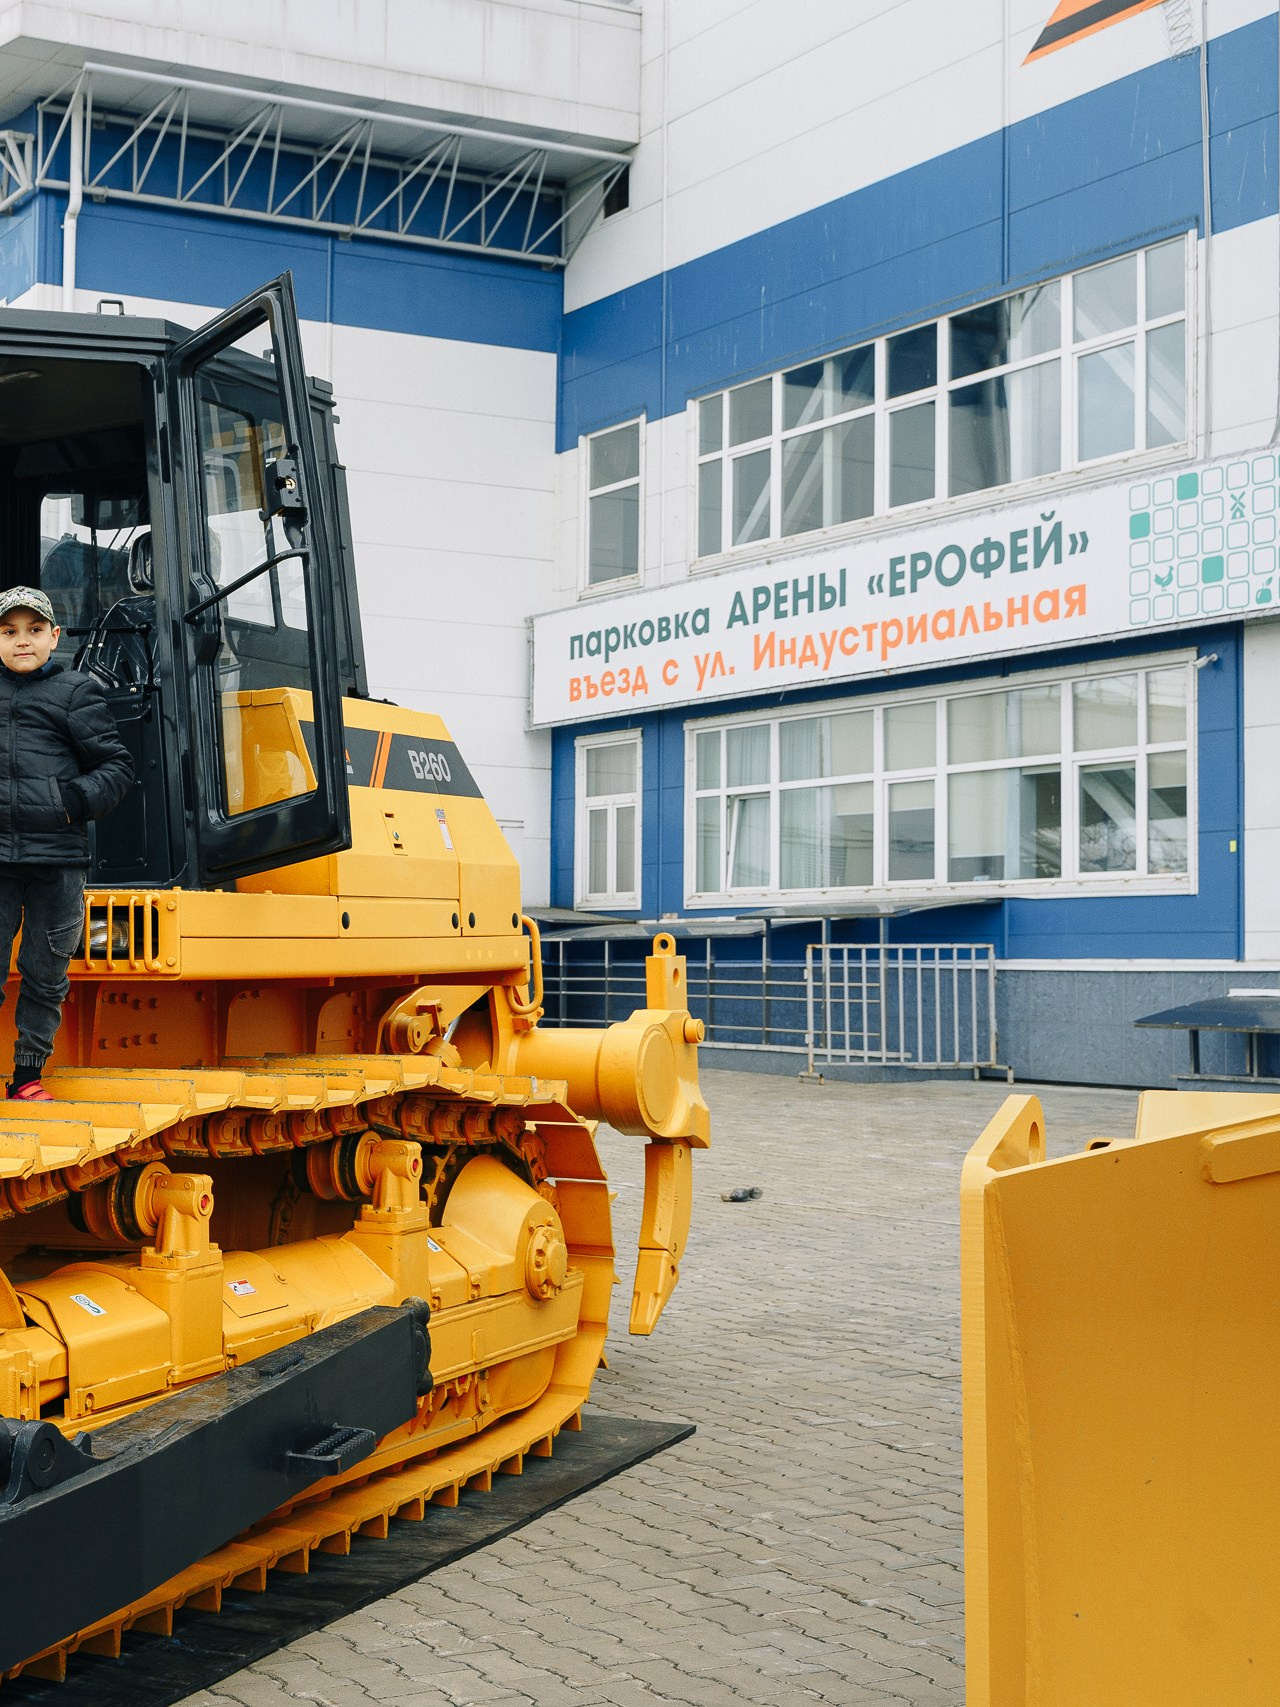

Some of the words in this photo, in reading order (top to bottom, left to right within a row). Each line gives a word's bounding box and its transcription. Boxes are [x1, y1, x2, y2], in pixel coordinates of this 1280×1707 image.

[570, 607, 710, 663] парковка
[727, 568, 846, 629] АРЕНЫ
[868, 510, 1089, 597] «ЕРОФЕЙ»
[570, 665, 648, 701] въезд
[663, 659, 679, 686] с
[694, 651, 735, 691] ул.
[753, 583, 1087, 671] Индустриальная
[408, 750, 452, 782] B260
